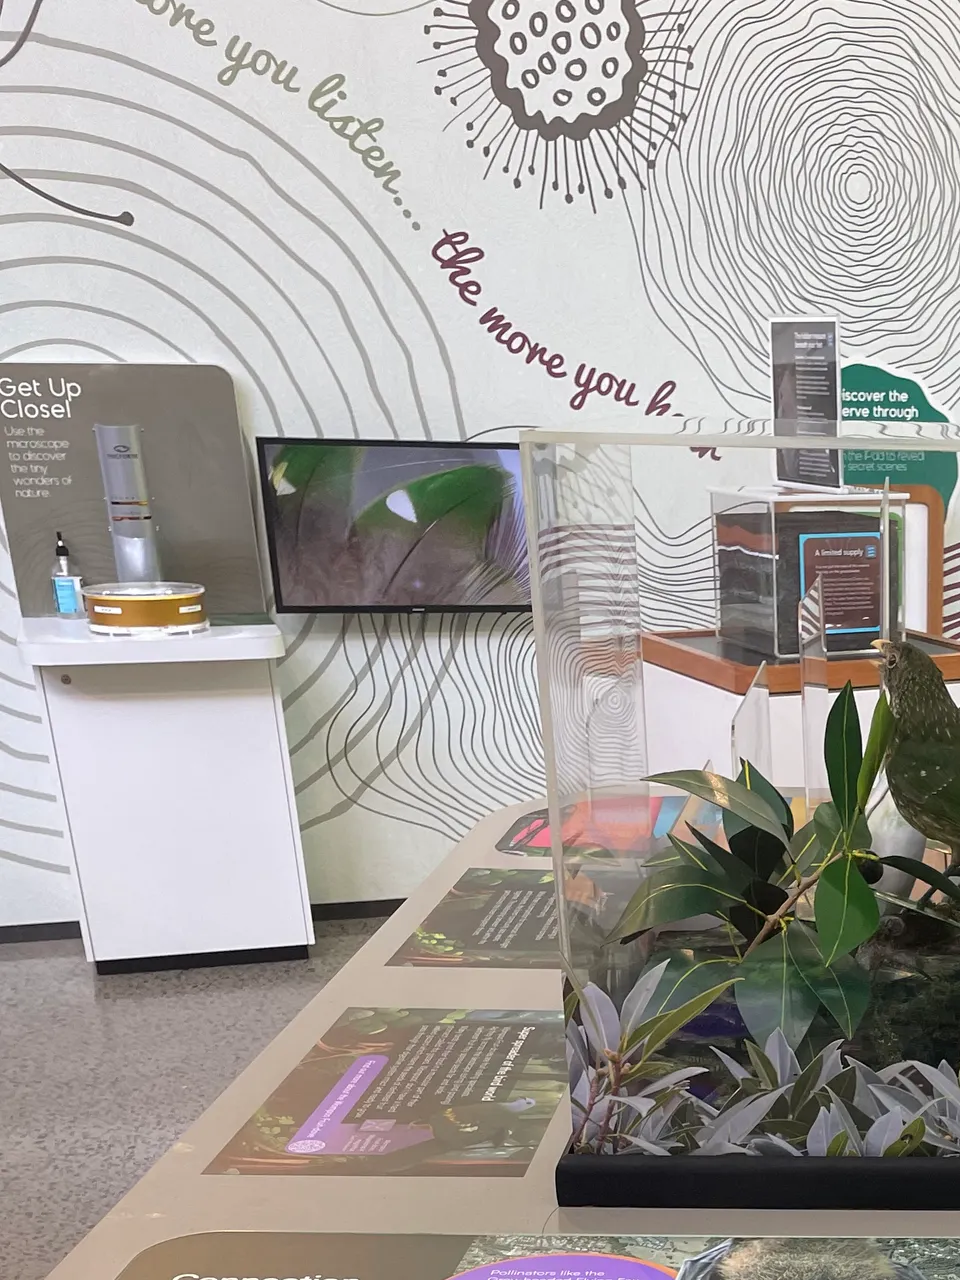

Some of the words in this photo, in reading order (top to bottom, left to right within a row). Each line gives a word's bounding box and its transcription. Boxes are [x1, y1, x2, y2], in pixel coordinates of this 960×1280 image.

[134, 0, 218, 47] ore
[217, 35, 301, 92] you
[431, 228, 484, 307] the
[479, 307, 567, 379] more
[569, 353, 640, 411] you
[0, 378, 42, 396] Get
[48, 378, 82, 401] Up
[841, 389, 886, 402] iscover
[889, 390, 908, 402] the
[842, 407, 869, 418] erve
[873, 406, 919, 420] through
[4, 426, 26, 436] Use
[27, 426, 45, 436] the
[6, 440, 70, 450] microscope
[8, 452, 20, 461] to
[22, 452, 66, 461] discover
[10, 464, 28, 473] the
[13, 476, 59, 486] wonders
[517, 1027, 535, 1040] Super
[506, 1040, 524, 1060] spreader
[497, 1067, 512, 1075] the
[490, 1076, 508, 1086] bird
[482, 1087, 497, 1101] world
